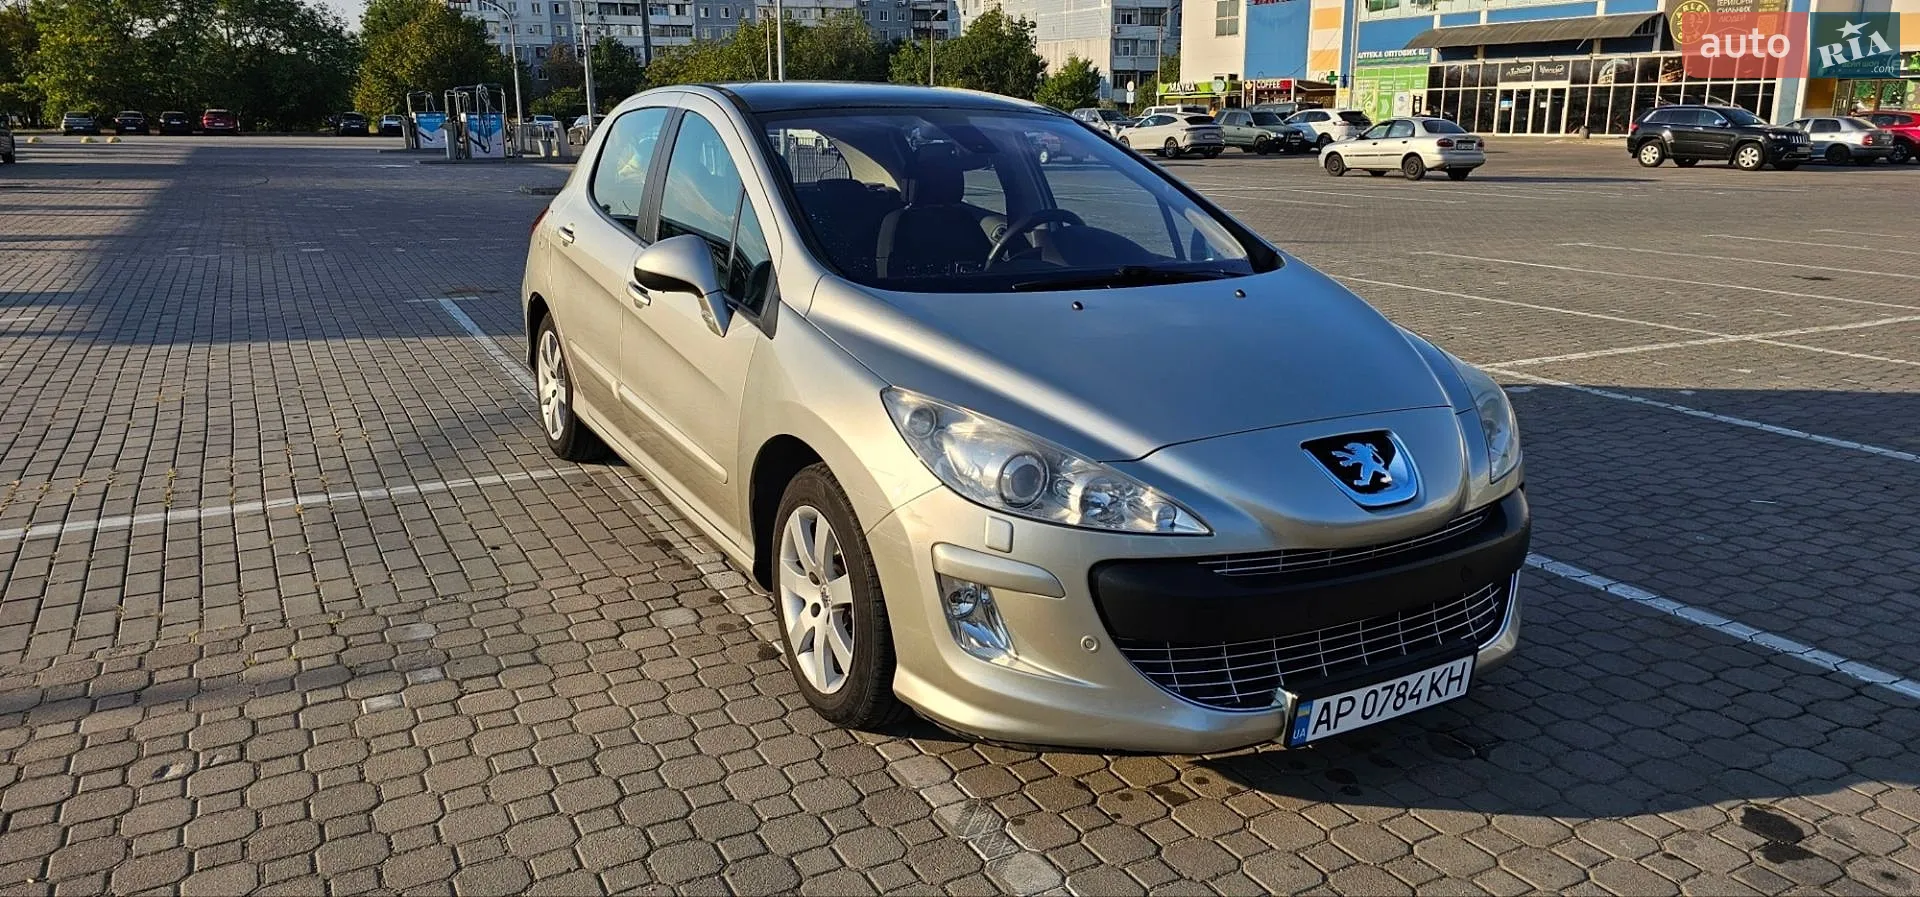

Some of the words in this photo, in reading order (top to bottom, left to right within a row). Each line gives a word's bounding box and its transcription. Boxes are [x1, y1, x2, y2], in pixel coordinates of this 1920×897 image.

[1256, 80, 1281, 89] COFFEE
[1312, 696, 1356, 735] AP
[1361, 675, 1425, 720] 0784
[1427, 662, 1466, 701] KH
[1293, 730, 1306, 740] UA
